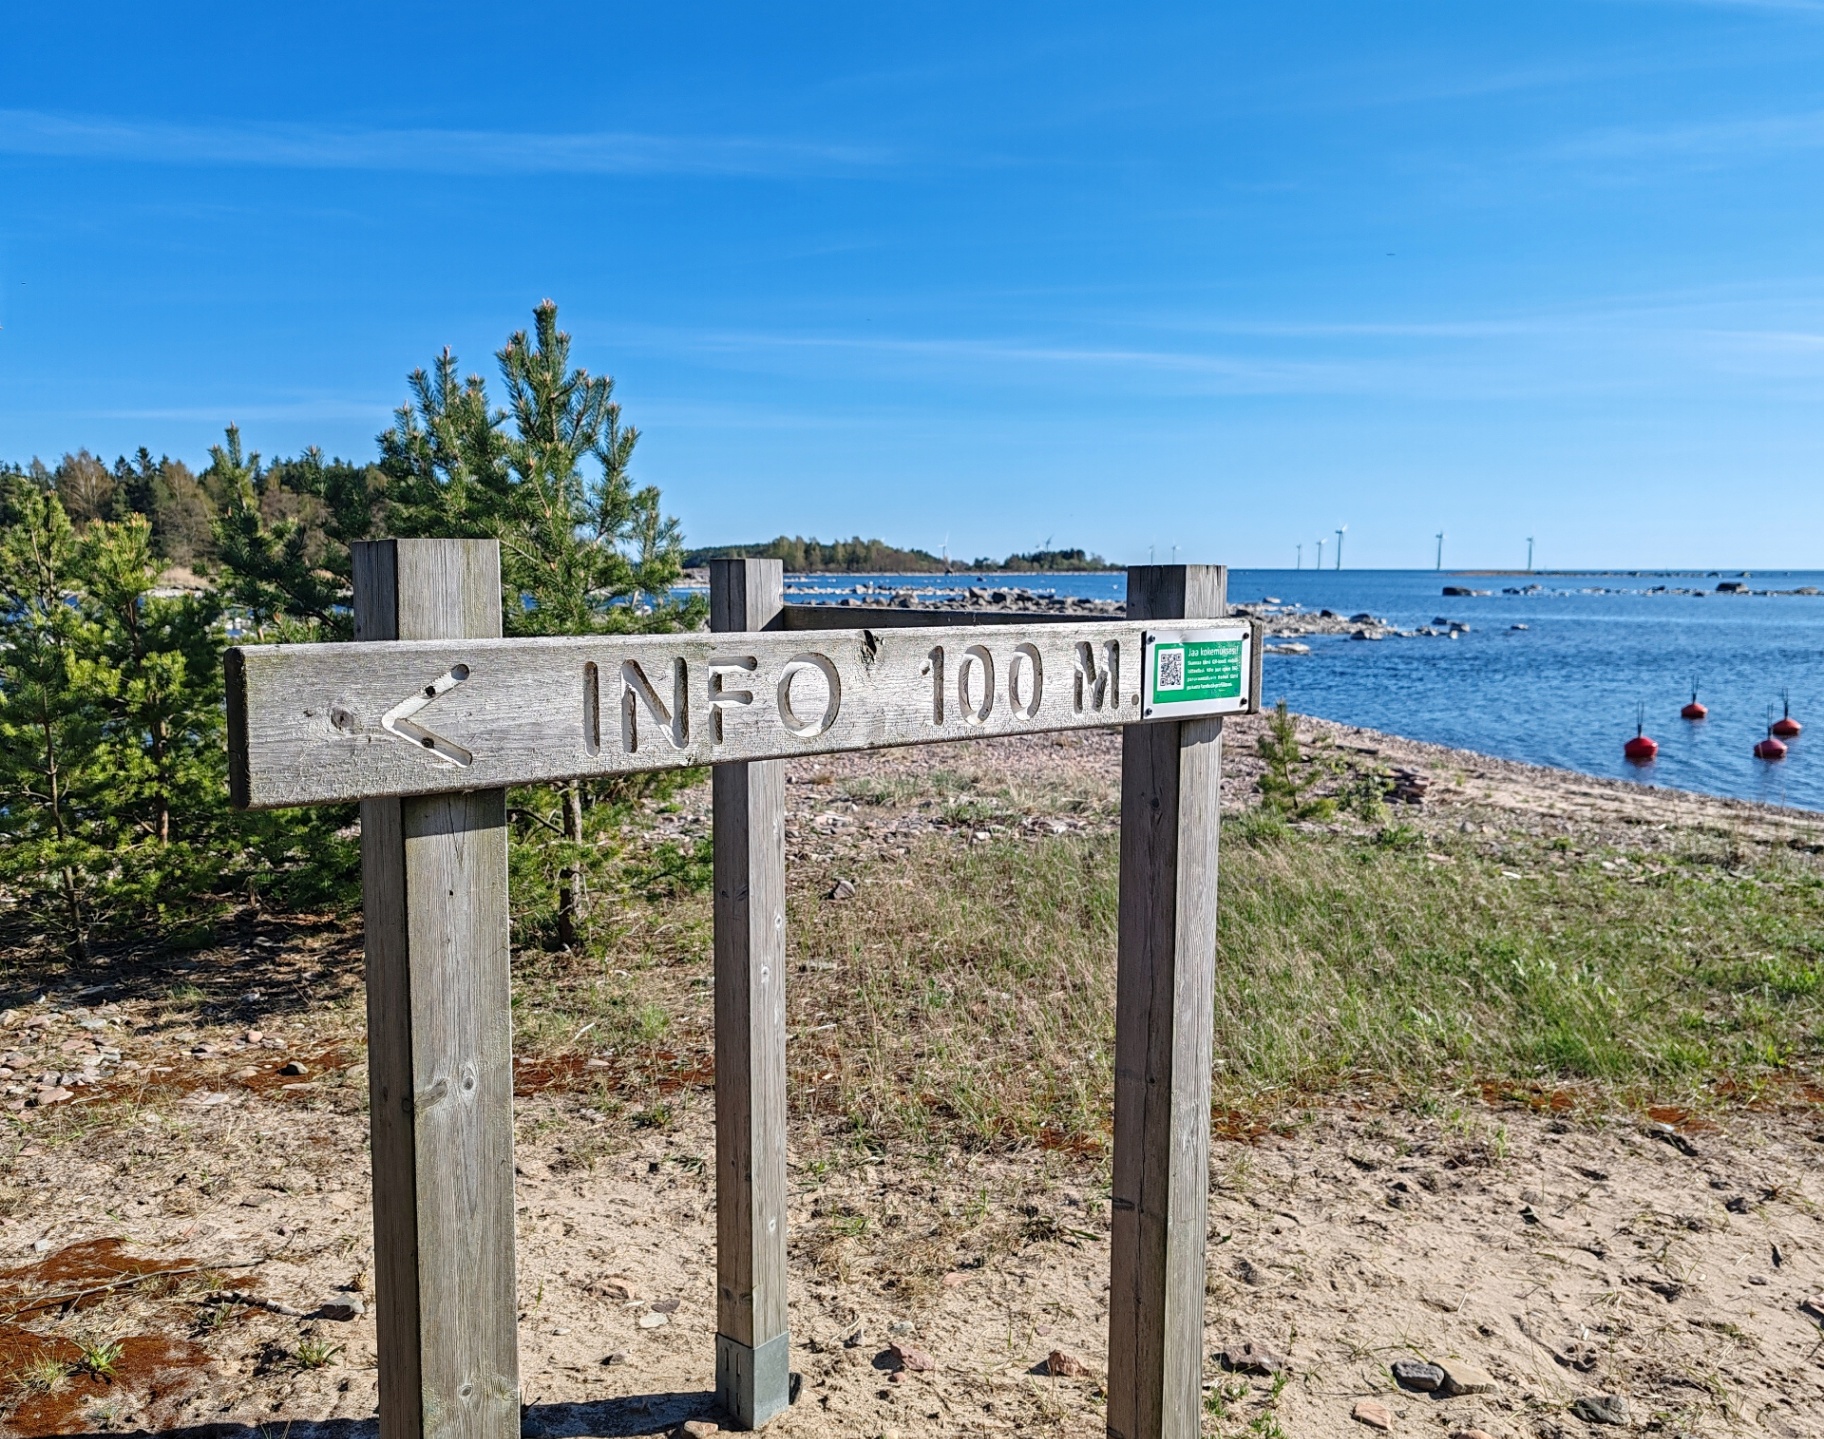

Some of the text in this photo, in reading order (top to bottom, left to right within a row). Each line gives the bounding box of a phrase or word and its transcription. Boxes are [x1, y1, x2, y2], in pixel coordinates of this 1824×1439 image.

[583, 639, 1120, 757] INFO 100 M
